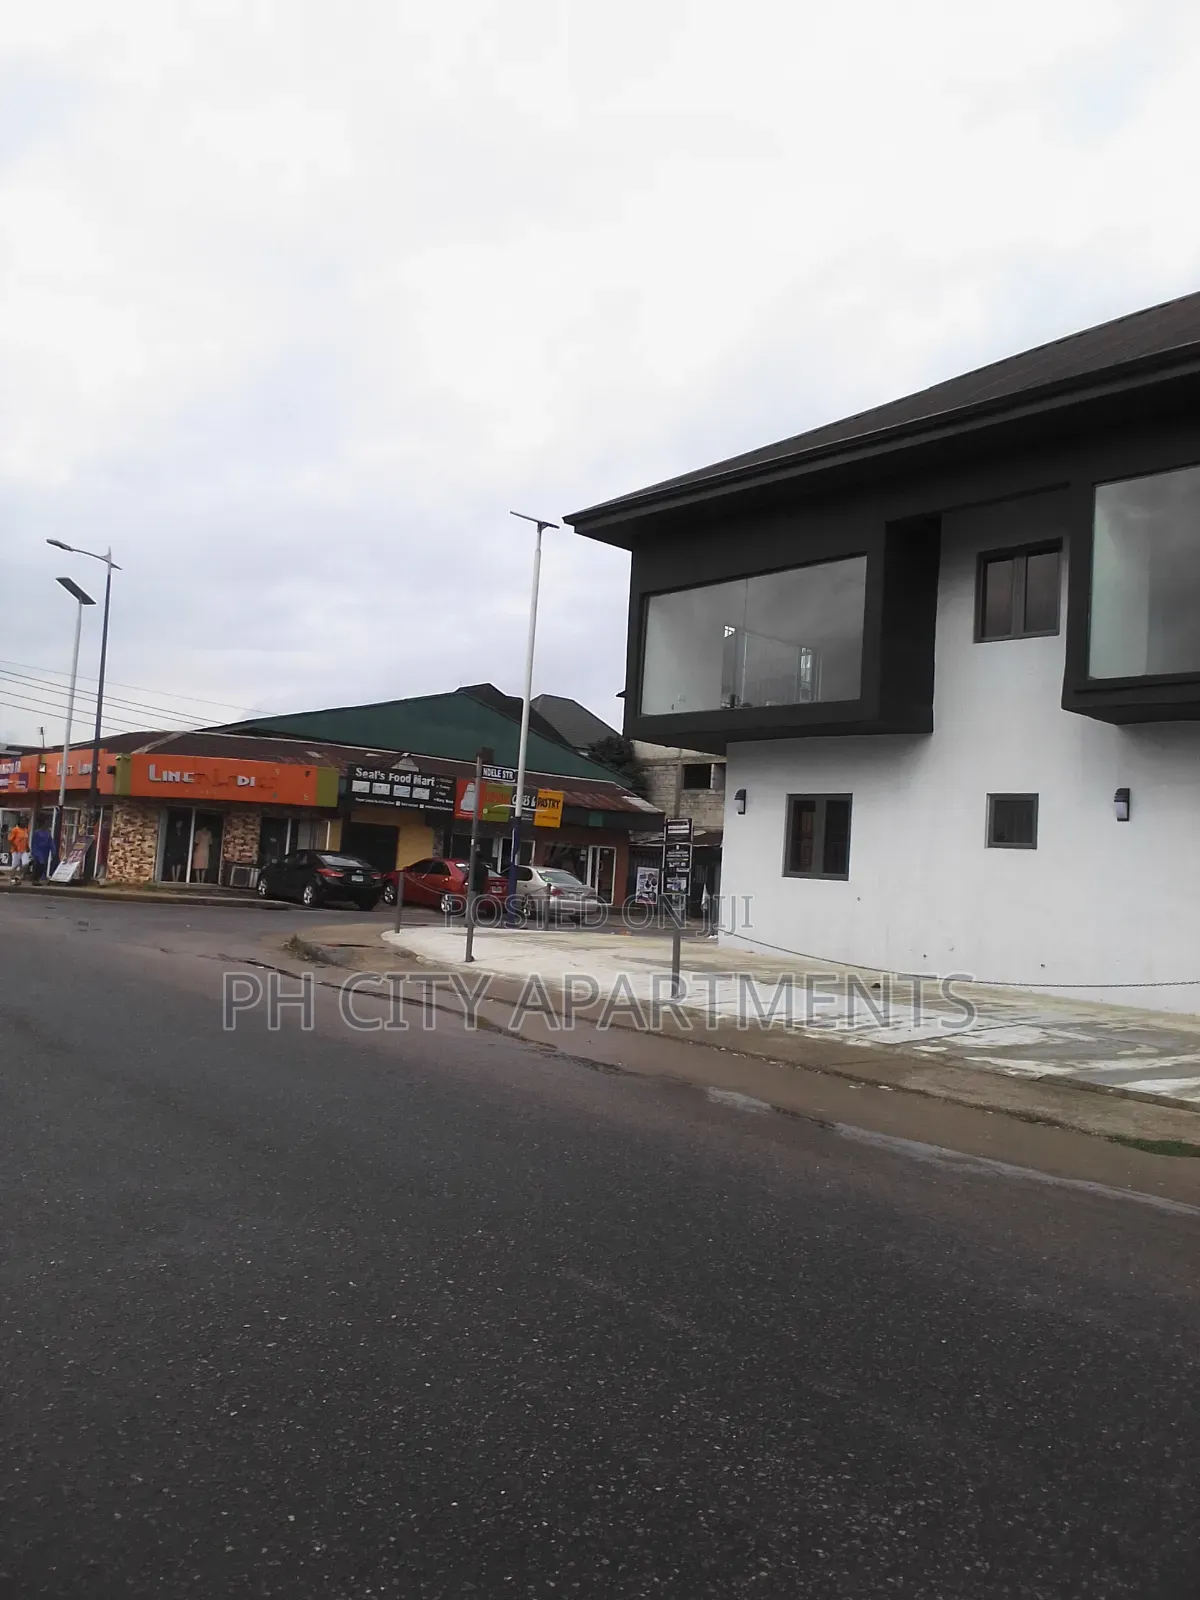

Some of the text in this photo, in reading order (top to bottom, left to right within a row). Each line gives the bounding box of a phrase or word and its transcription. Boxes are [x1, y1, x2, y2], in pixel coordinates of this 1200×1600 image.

[355, 767, 386, 781] Seal's
[388, 773, 412, 785] Food
[413, 774, 435, 787] Mart
[502, 770, 514, 780] STR
[537, 796, 561, 810] PASTRY
